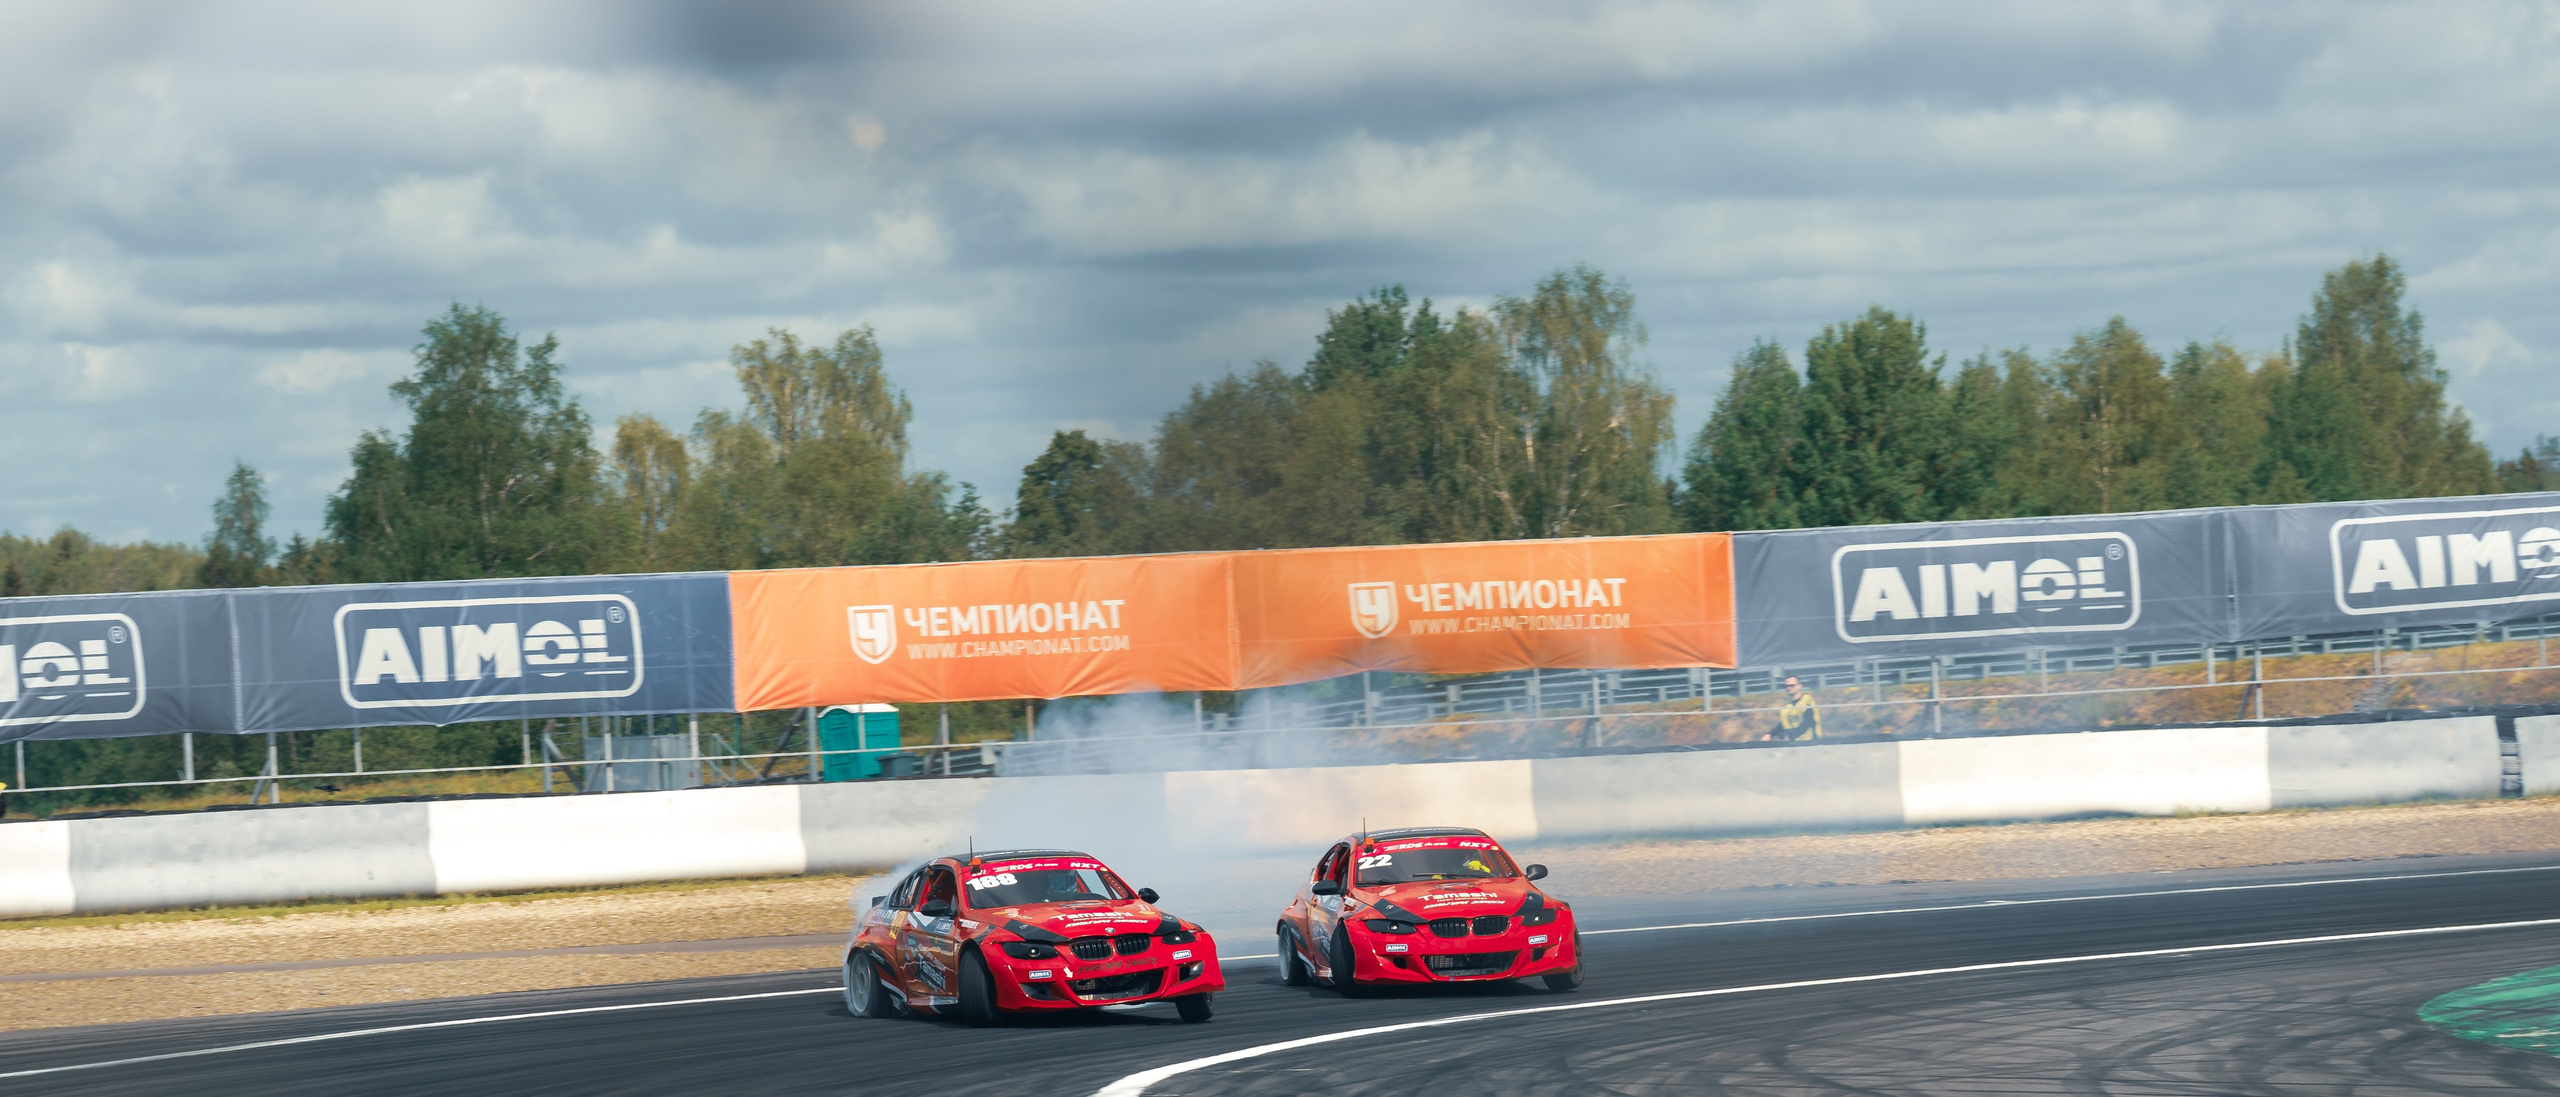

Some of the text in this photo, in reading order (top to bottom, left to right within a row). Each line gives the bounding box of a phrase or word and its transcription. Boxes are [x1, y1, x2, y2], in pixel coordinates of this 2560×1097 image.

[1405, 577, 1628, 613] ЧЕМПИОНАТ
[1848, 556, 2126, 623] AIMOL
[903, 599, 1127, 637] ЧЕМПИОНАТ
[1408, 612, 1631, 635] WWW.CHAMPIONAT.COM
[353, 618, 629, 686] AIMOL
[906, 635, 1131, 660] WWW.CHAMPIONAT.COM
[0, 640, 131, 703] OL
[1357, 854, 1393, 870] 22
[966, 872, 1018, 891] 188
[1417, 892, 1498, 902] Tamashi
[1050, 911, 1134, 921] Tamashi
[1076, 960, 1123, 974] КУЛЬТУРА
